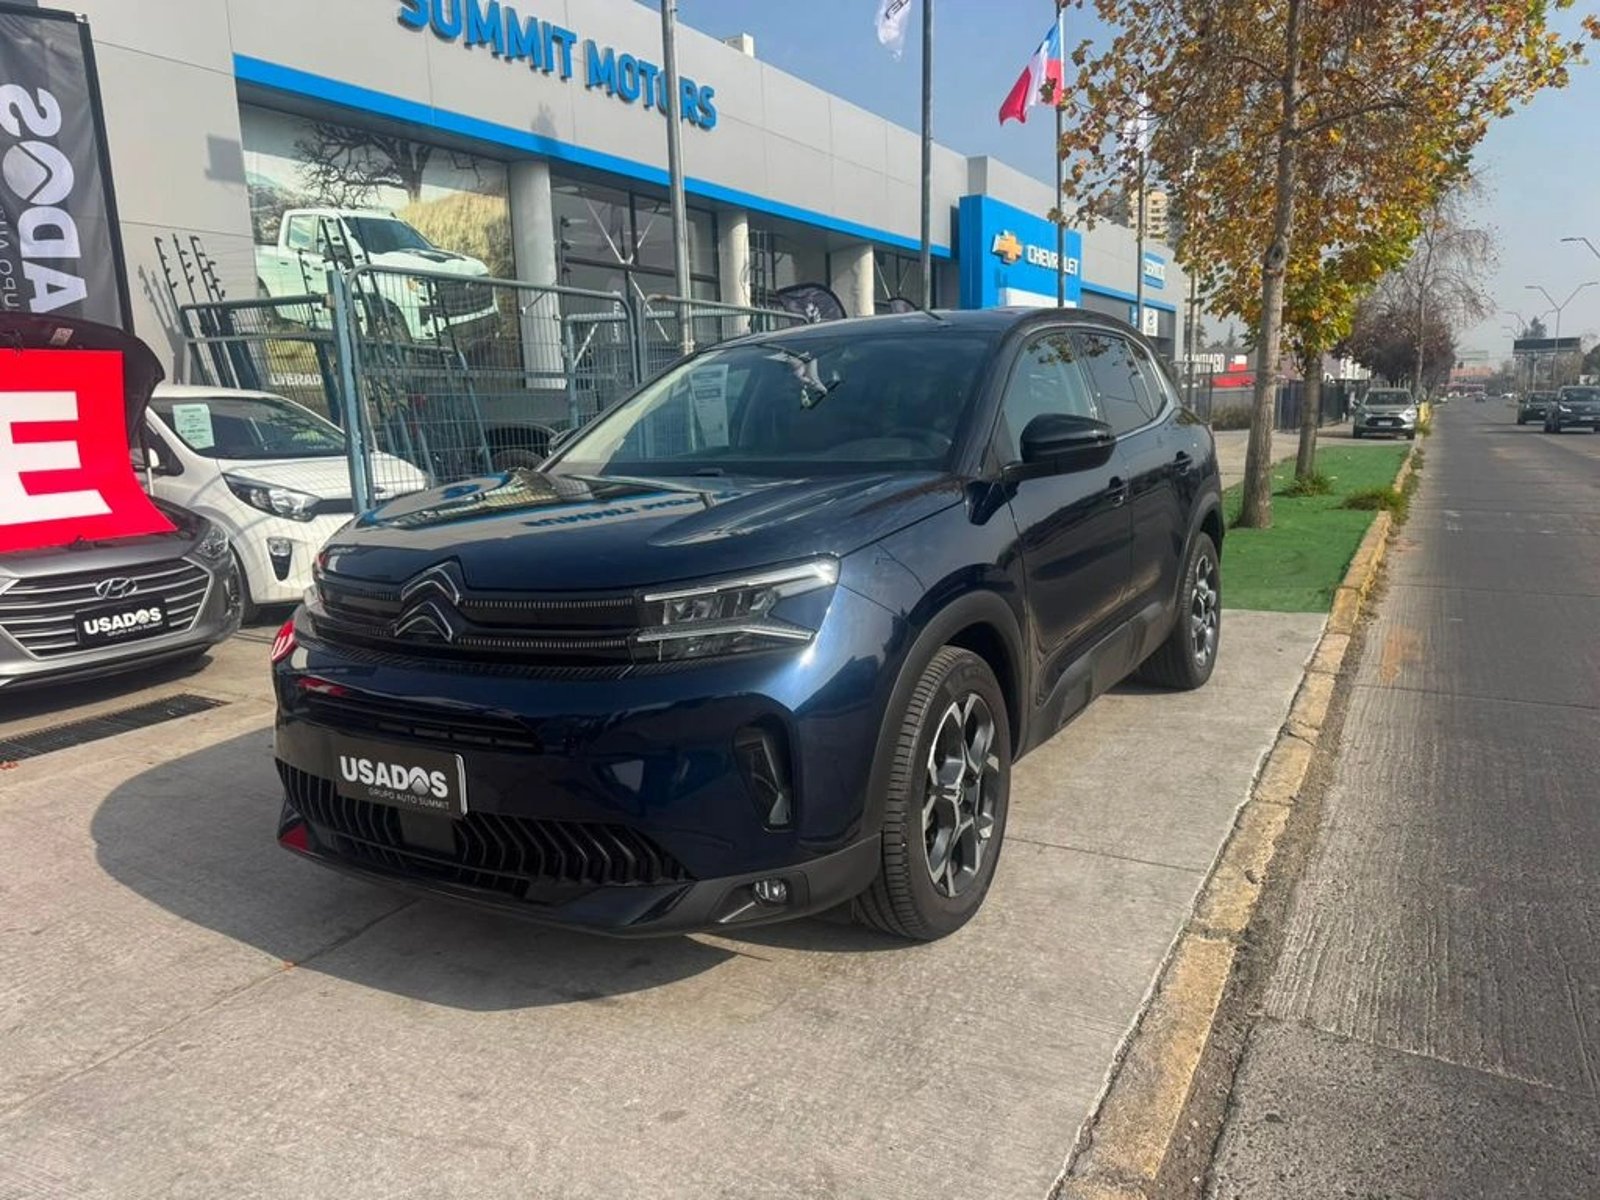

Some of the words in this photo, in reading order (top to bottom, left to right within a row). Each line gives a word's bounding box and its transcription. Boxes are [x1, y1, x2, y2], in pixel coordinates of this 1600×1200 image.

[1027, 245, 1079, 276] CHEVRLET
[84, 607, 162, 635] USADOS
[340, 755, 449, 799] USADOS
[396, 793, 418, 804] AUTO
